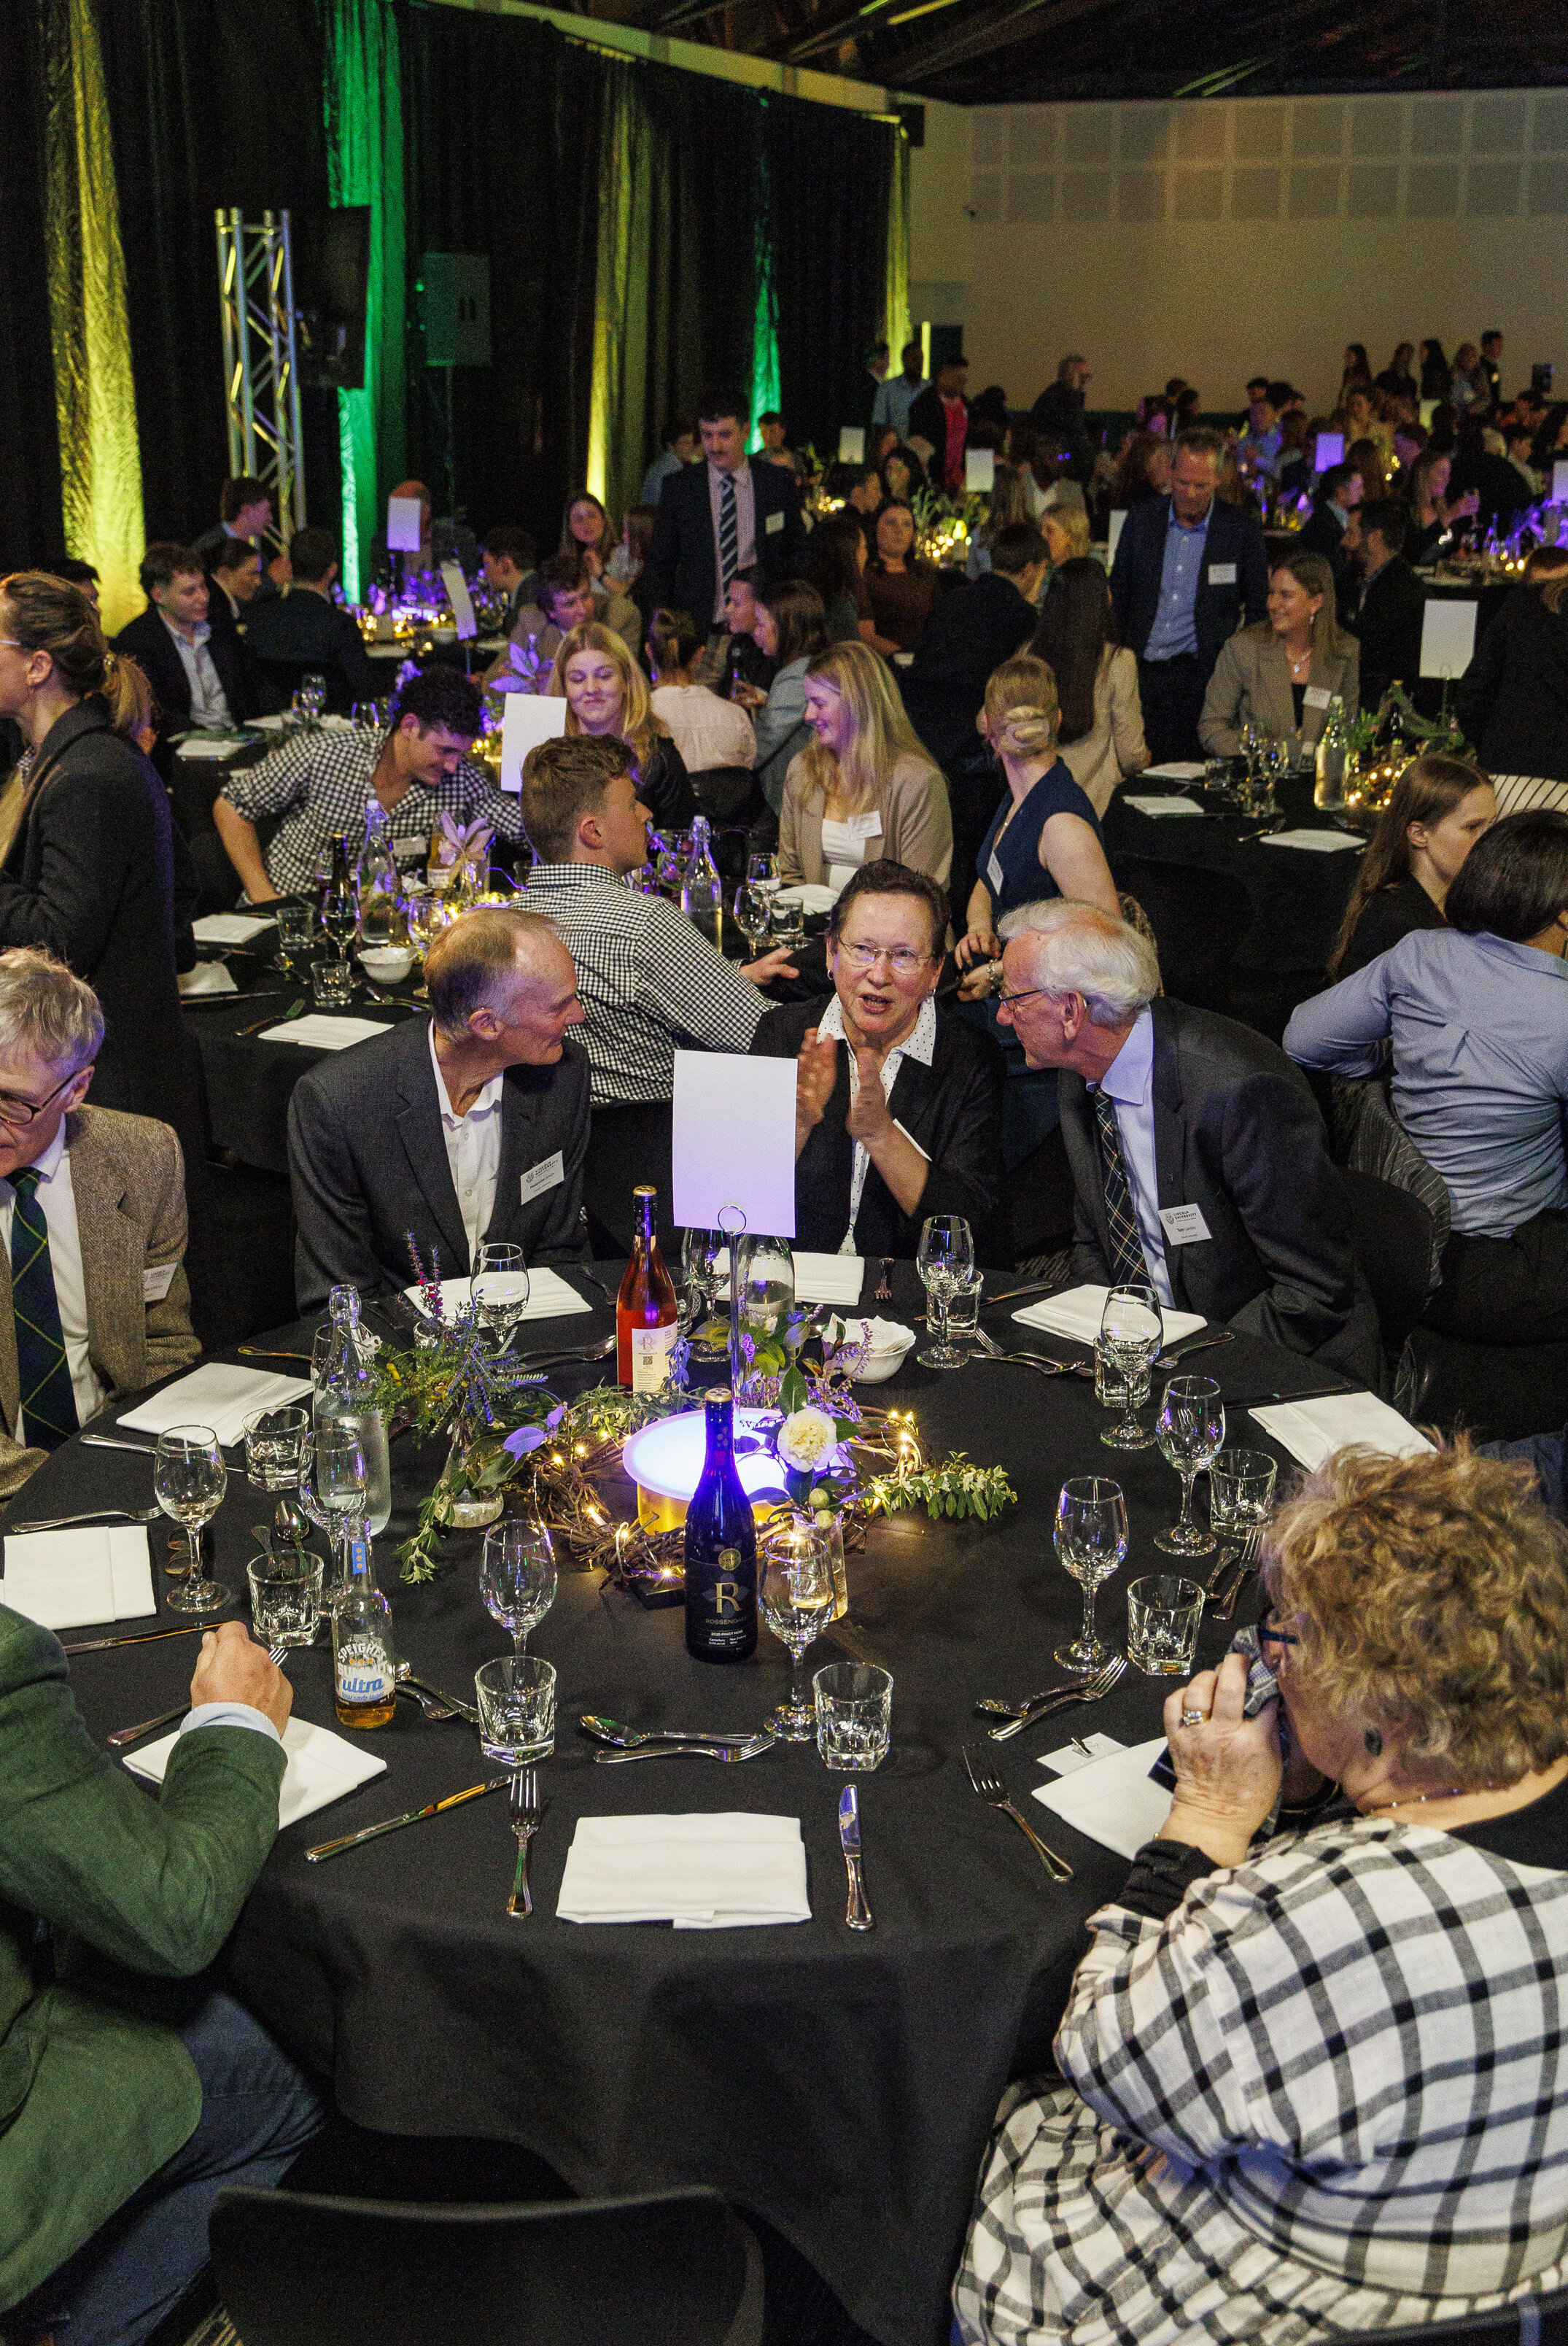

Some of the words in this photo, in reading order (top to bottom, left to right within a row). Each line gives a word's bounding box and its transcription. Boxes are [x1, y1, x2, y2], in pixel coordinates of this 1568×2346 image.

[643, 1336, 653, 1350] R
[710, 1582, 742, 1614] R
[342, 1677, 384, 1693] ultra
